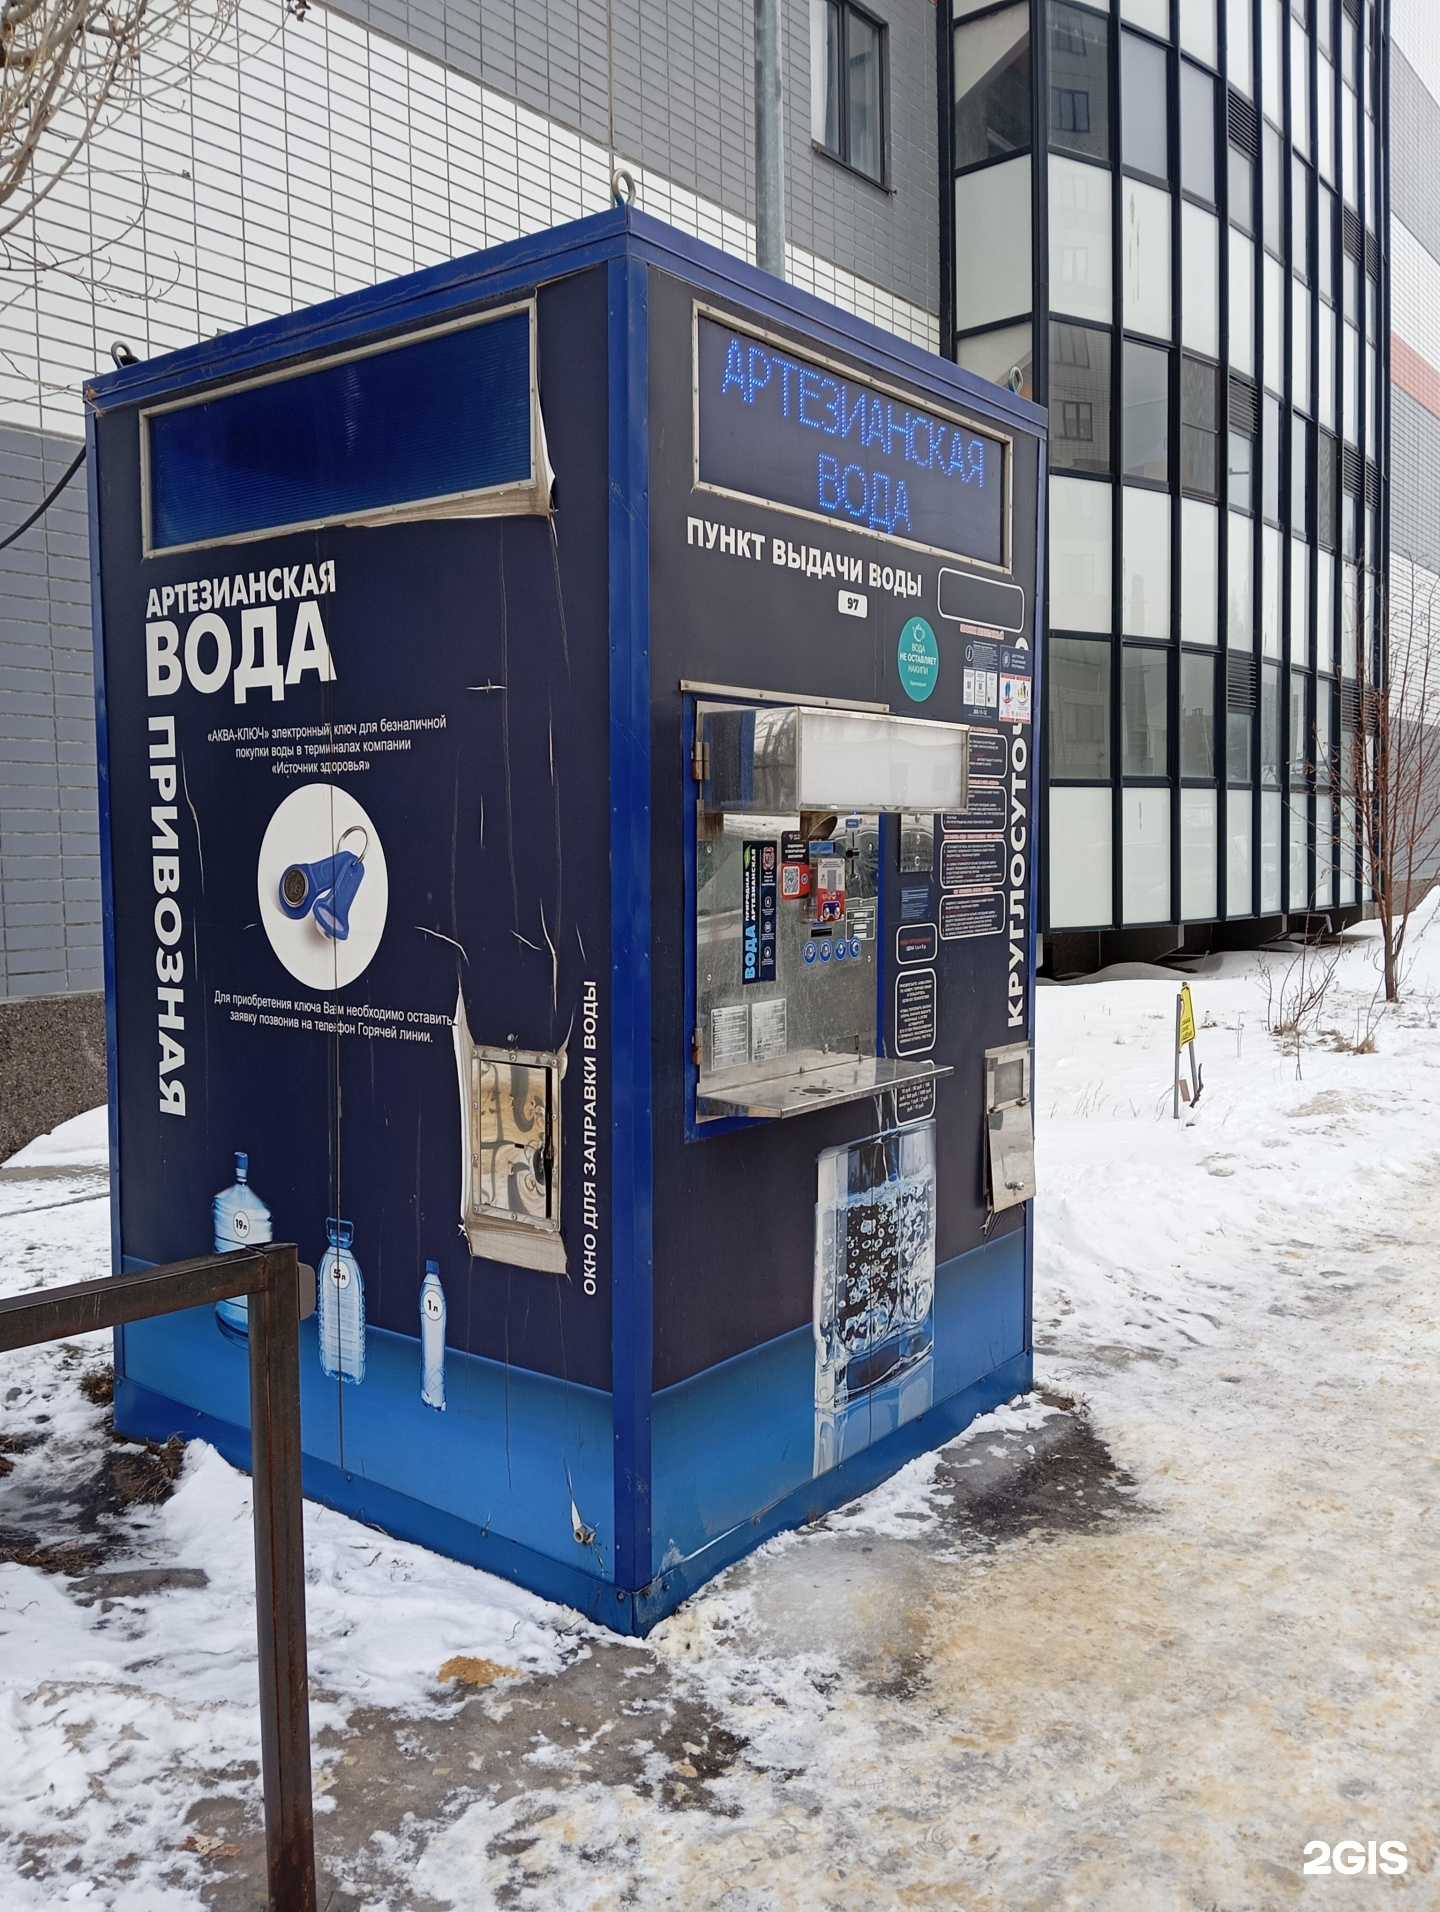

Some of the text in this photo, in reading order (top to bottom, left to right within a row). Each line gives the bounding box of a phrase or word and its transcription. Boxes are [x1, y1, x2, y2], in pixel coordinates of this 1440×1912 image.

[721, 337, 985, 489] АРТЕЗИАНСКАЯ
[818, 452, 912, 534] ВОДА
[687, 516, 922, 597] ПУНКТ ВЫДАЧИ ВОДЫ
[146, 559, 336, 619] АРТЕЗИАНСКАЯ
[846, 597, 860, 611] 97
[145, 600, 337, 704] ВОДА
[207, 714, 447, 742] «АКВА-КЛЮЧ» электронный ключ для безналичной
[235, 737, 411, 760] покупки воды в терминалах компании
[271, 758, 370, 775] «Источник здоровья»
[1008, 637, 1029, 1027] КРУГЛОСУТО
[148, 715, 186, 1117] ПРИВОЗНАЯ
[745, 924, 757, 979] ВОДА
[214, 990, 230, 1005] Для
[232, 993, 292, 1011] приобретения
[294, 1001, 321, 1014] ключа
[346, 1004, 405, 1023] необходимо
[407, 1010, 453, 1027] оставить
[230, 1010, 257, 1026] заявку
[259, 1014, 299, 1029] позвонив
[301, 1020, 313, 1030] на
[358, 1023, 397, 1039] Горячей
[399, 1030, 433, 1043] линии.
[584, 981, 598, 1297] ОКНО ДЛЯ ЗАПРАВКИ ВОДЫ
